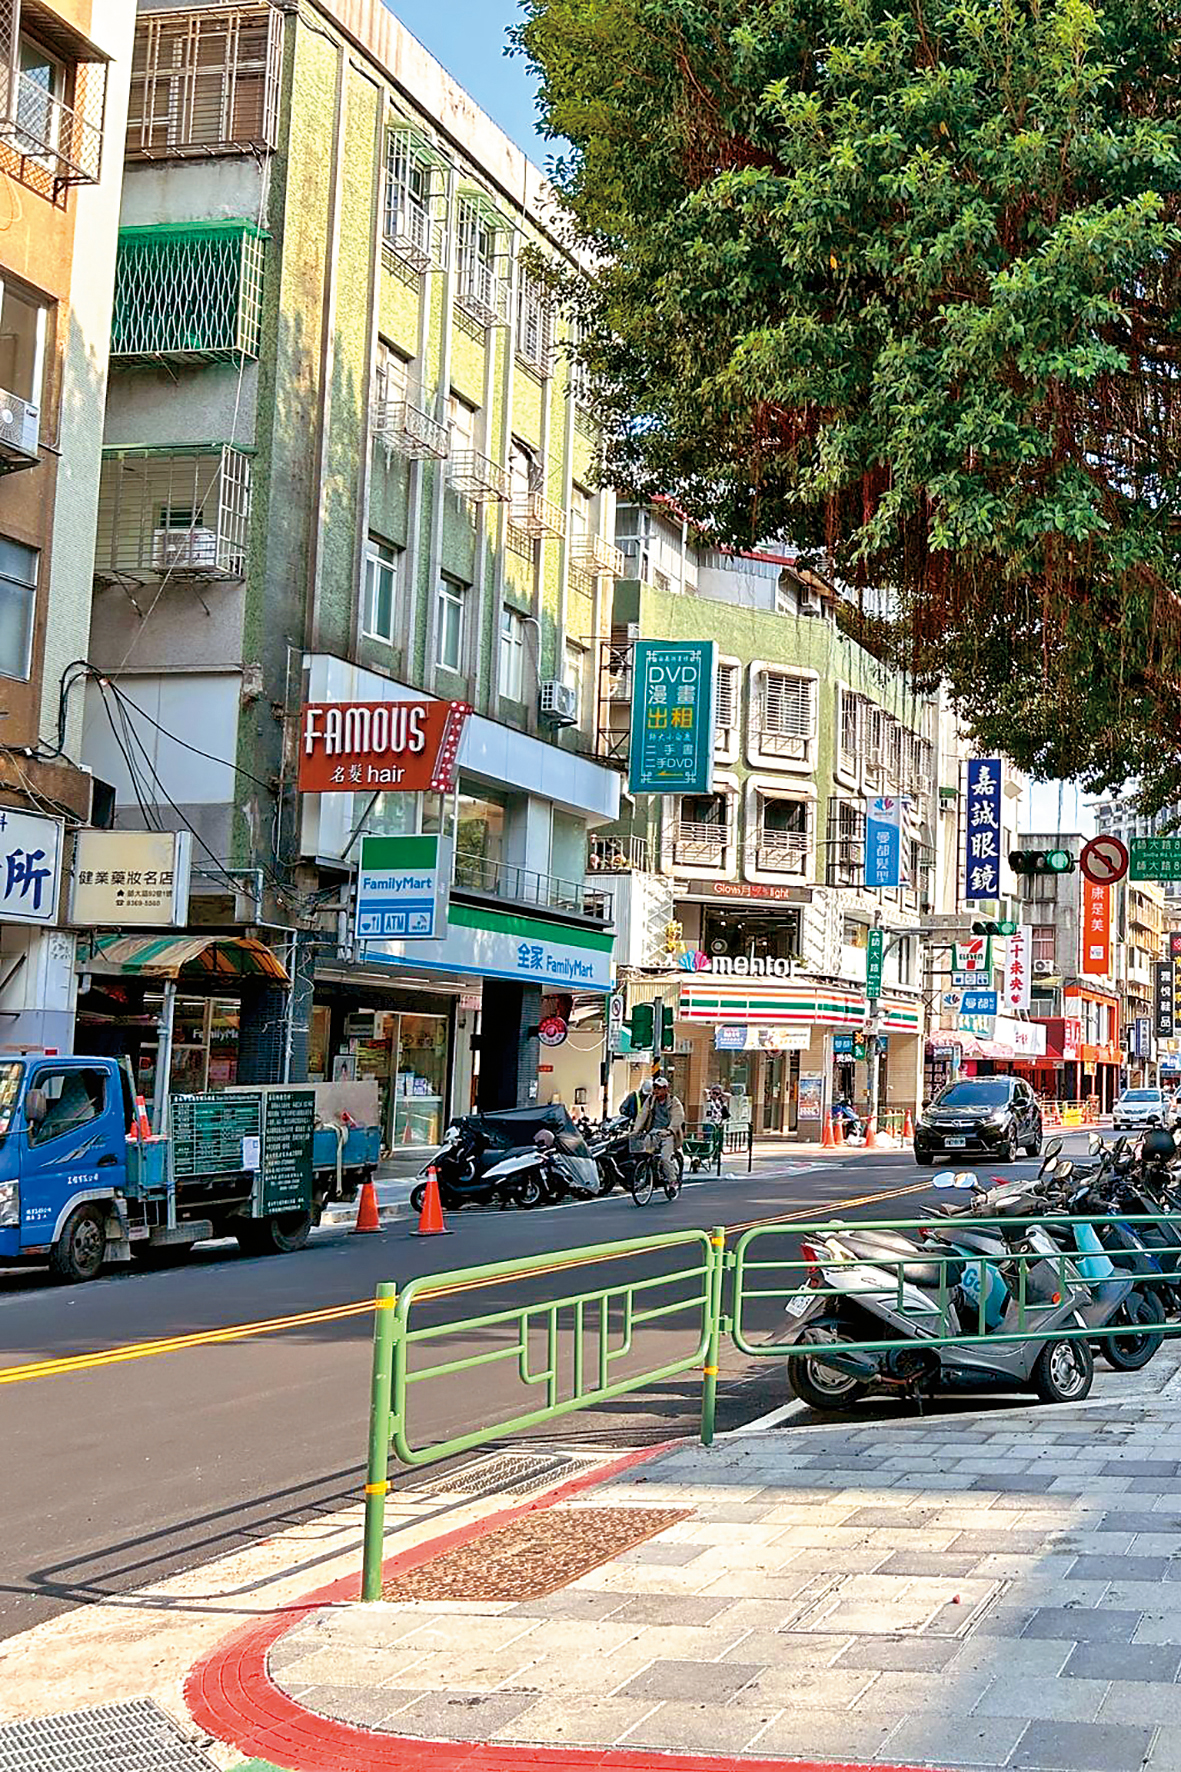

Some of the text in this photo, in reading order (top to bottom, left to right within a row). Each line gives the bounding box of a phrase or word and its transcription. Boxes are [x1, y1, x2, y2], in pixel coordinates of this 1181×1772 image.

[648, 666, 697, 683] DVD
[648, 685, 696, 705] 漫畫
[647, 707, 693, 729] 出租
[304, 706, 427, 755] FAMOUS
[645, 758, 693, 769] 二手DVD
[329, 764, 406, 784] 名髮 hair
[970, 765, 999, 893] 嘉誠眼鏡
[4, 848, 52, 910] 所
[78, 870, 174, 885] 健業藥妝名店
[363, 877, 432, 892] FamilyMart
[1091, 886, 1105, 932] 康是美
[386, 915, 405, 930] ATM
[517, 943, 594, 979] 全家 FamilyMart
